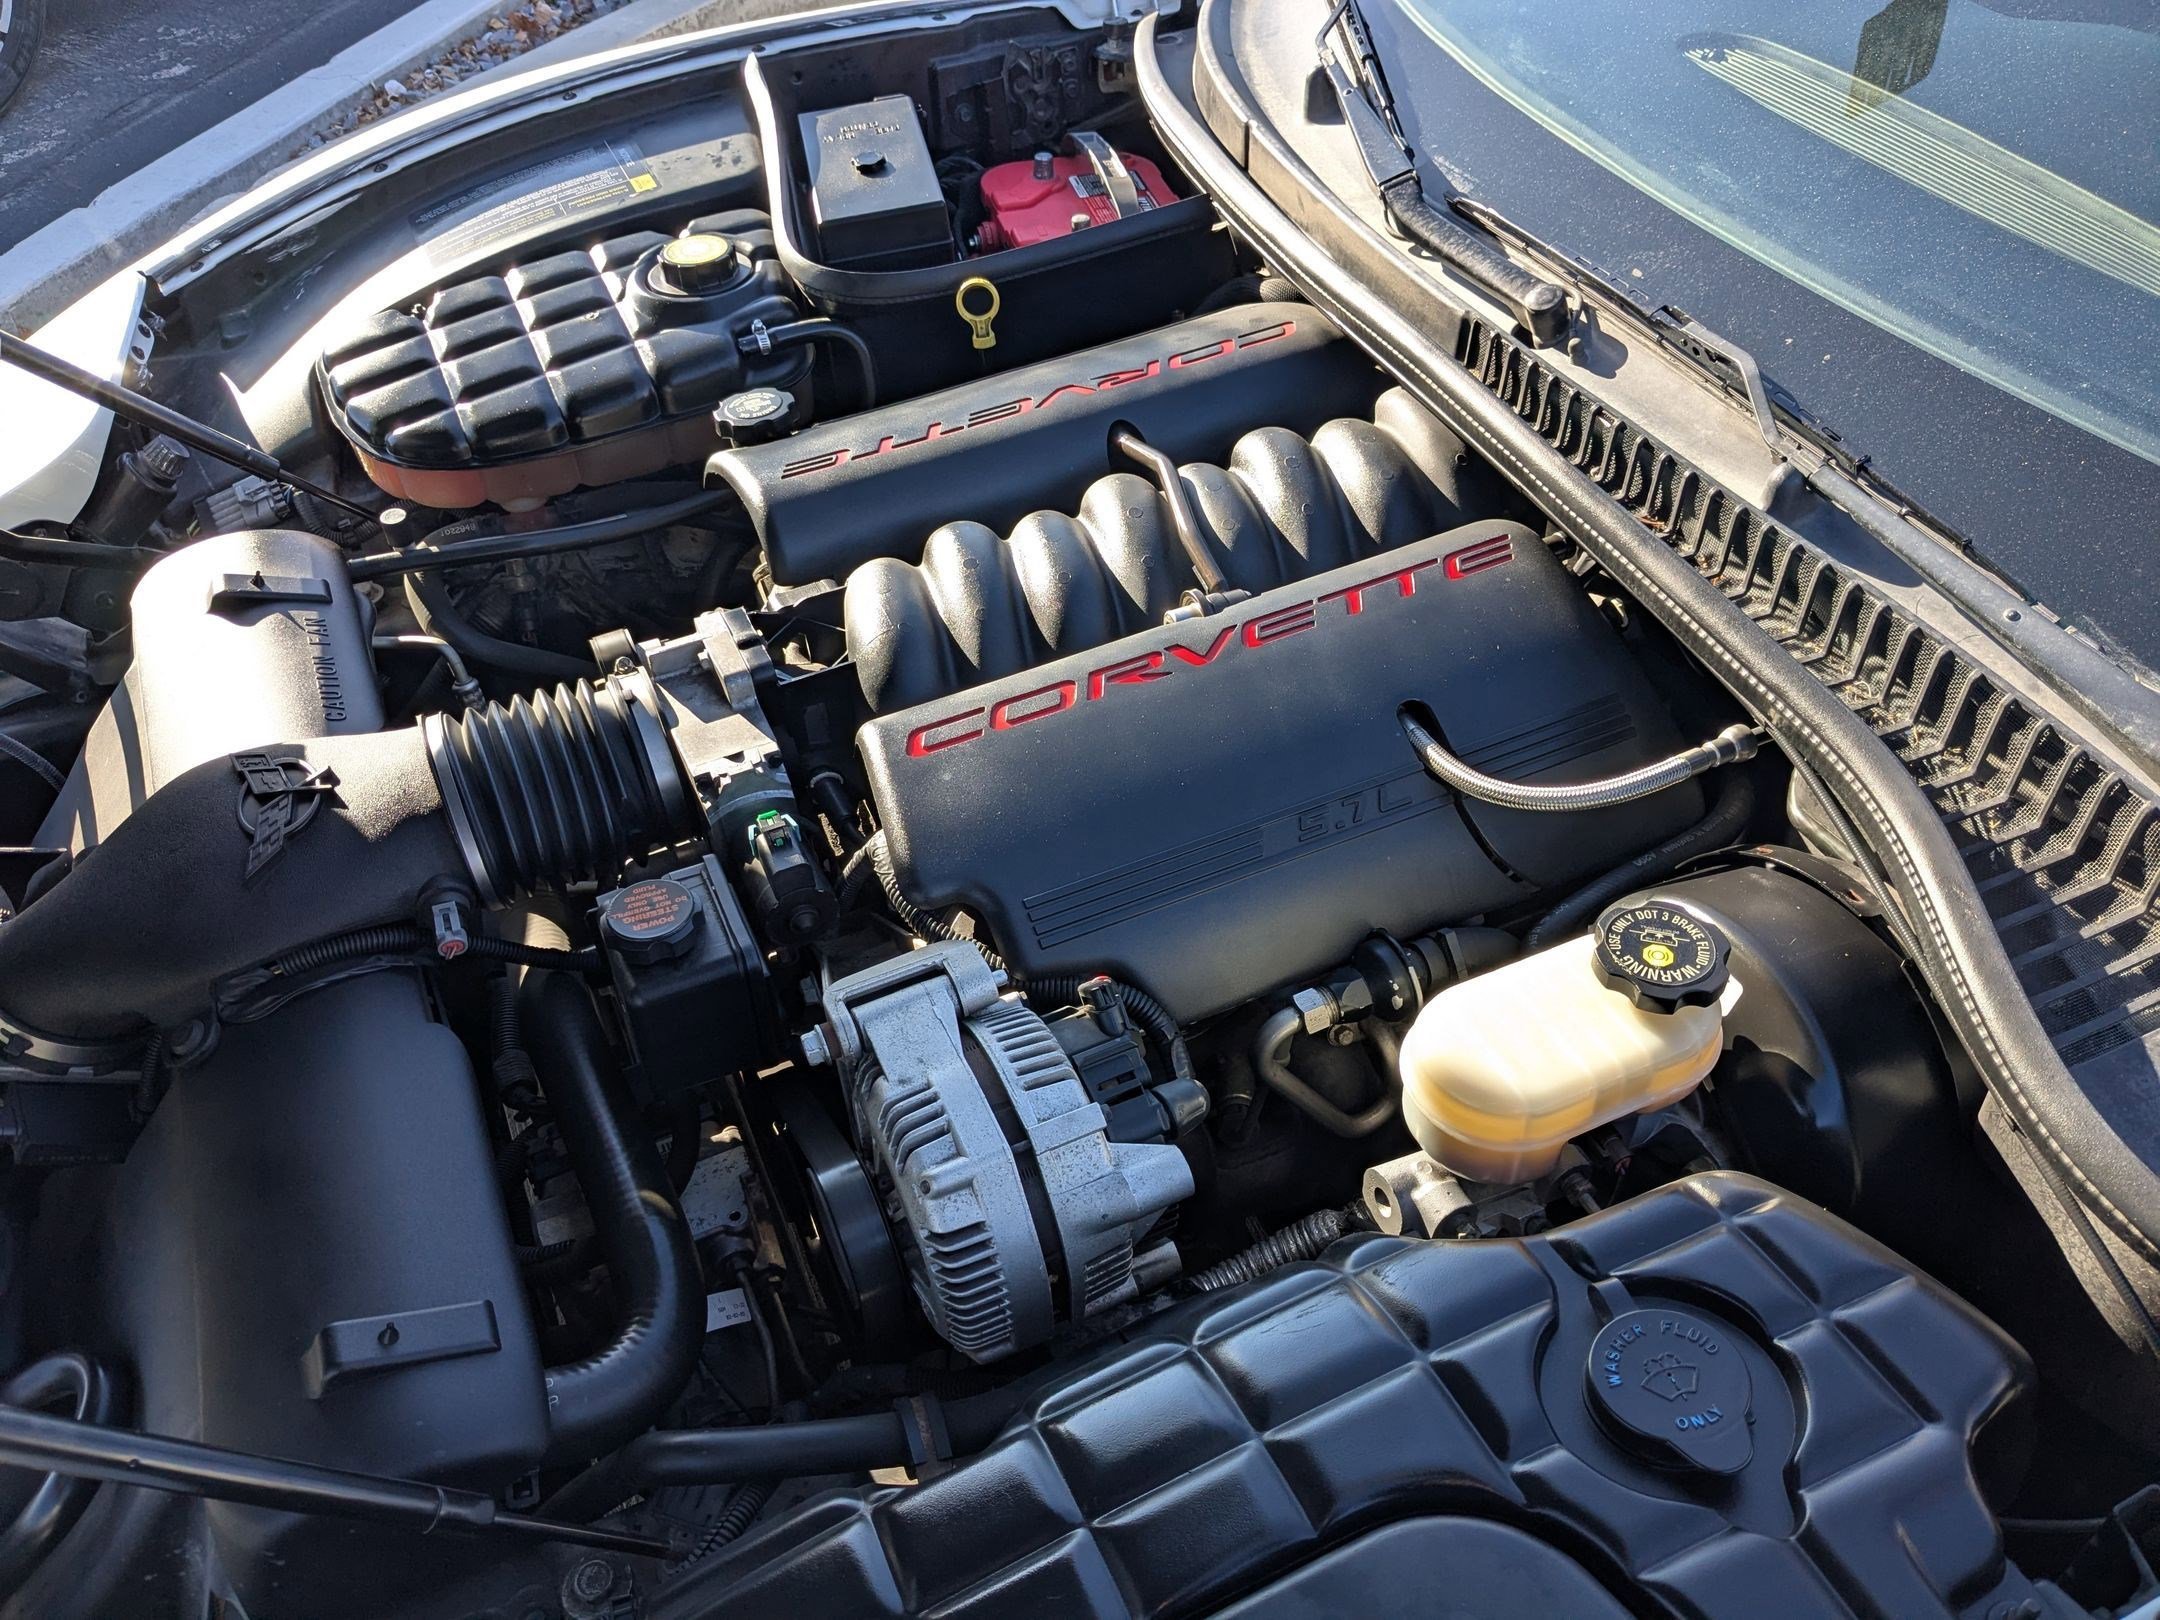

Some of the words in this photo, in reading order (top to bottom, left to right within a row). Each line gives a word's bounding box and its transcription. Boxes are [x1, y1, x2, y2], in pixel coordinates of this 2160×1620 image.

[781, 320, 1296, 479] CORVETTE
[302, 616, 332, 646] FAN
[905, 533, 1513, 758] CORVETTE
[311, 655, 348, 722] CAUTION
[1298, 787, 1414, 843] 5.7L
[624, 888, 667, 903] APPROVED
[632, 884, 656, 894] FLUID
[674, 895, 688, 903] DO
[623, 904, 680, 924] STEERING
[627, 900, 648, 909] ONLY
[1635, 909, 1658, 920] DOT
[632, 915, 675, 931] POWER
[1611, 913, 1635, 933] ONLY
[1662, 911, 1670, 921] 3
[1671, 915, 1705, 940] BRAKE
[1608, 933, 1622, 950] USE
[1695, 941, 1711, 966] FLUID
[1622, 954, 1701, 982] WARNING
[1604, 1321, 1647, 1389] WASHER
[1660, 1319, 1719, 1354] FLUID
[1675, 1403, 1723, 1431] ONLY
